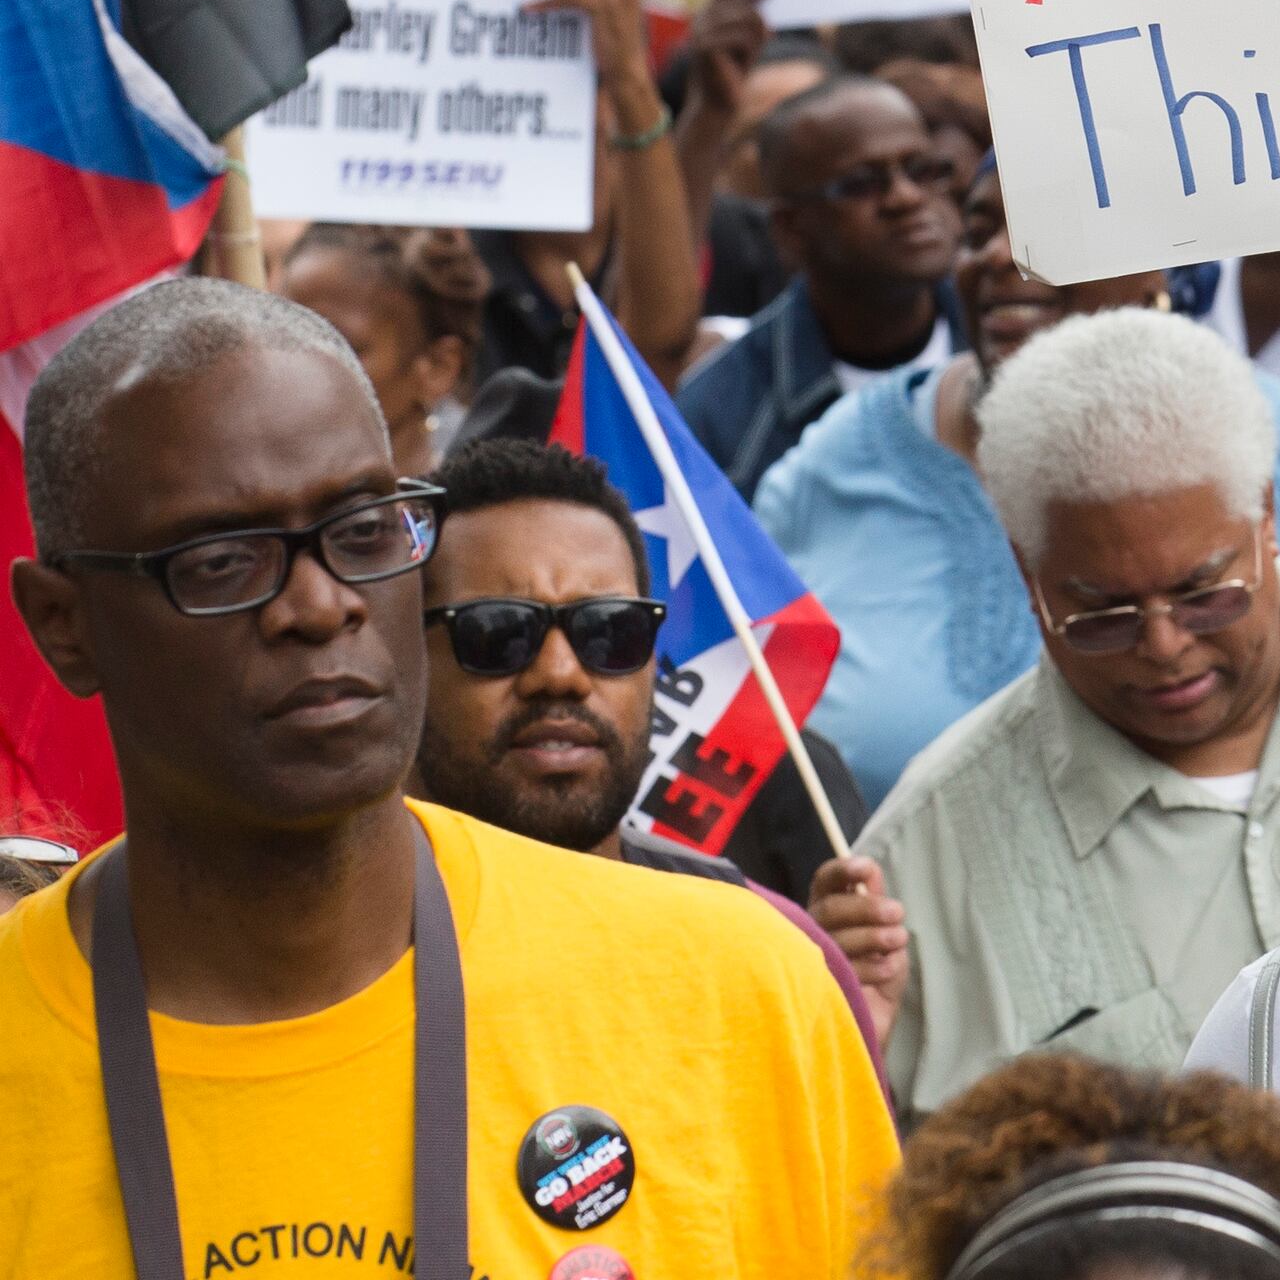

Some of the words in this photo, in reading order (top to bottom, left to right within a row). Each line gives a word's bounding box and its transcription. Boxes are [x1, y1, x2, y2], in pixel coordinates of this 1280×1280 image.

[334, 86, 424, 141] many
[535, 1176, 569, 1207] GO
[565, 1135, 628, 1187] BACK
[203, 1221, 367, 1280] ACTION
